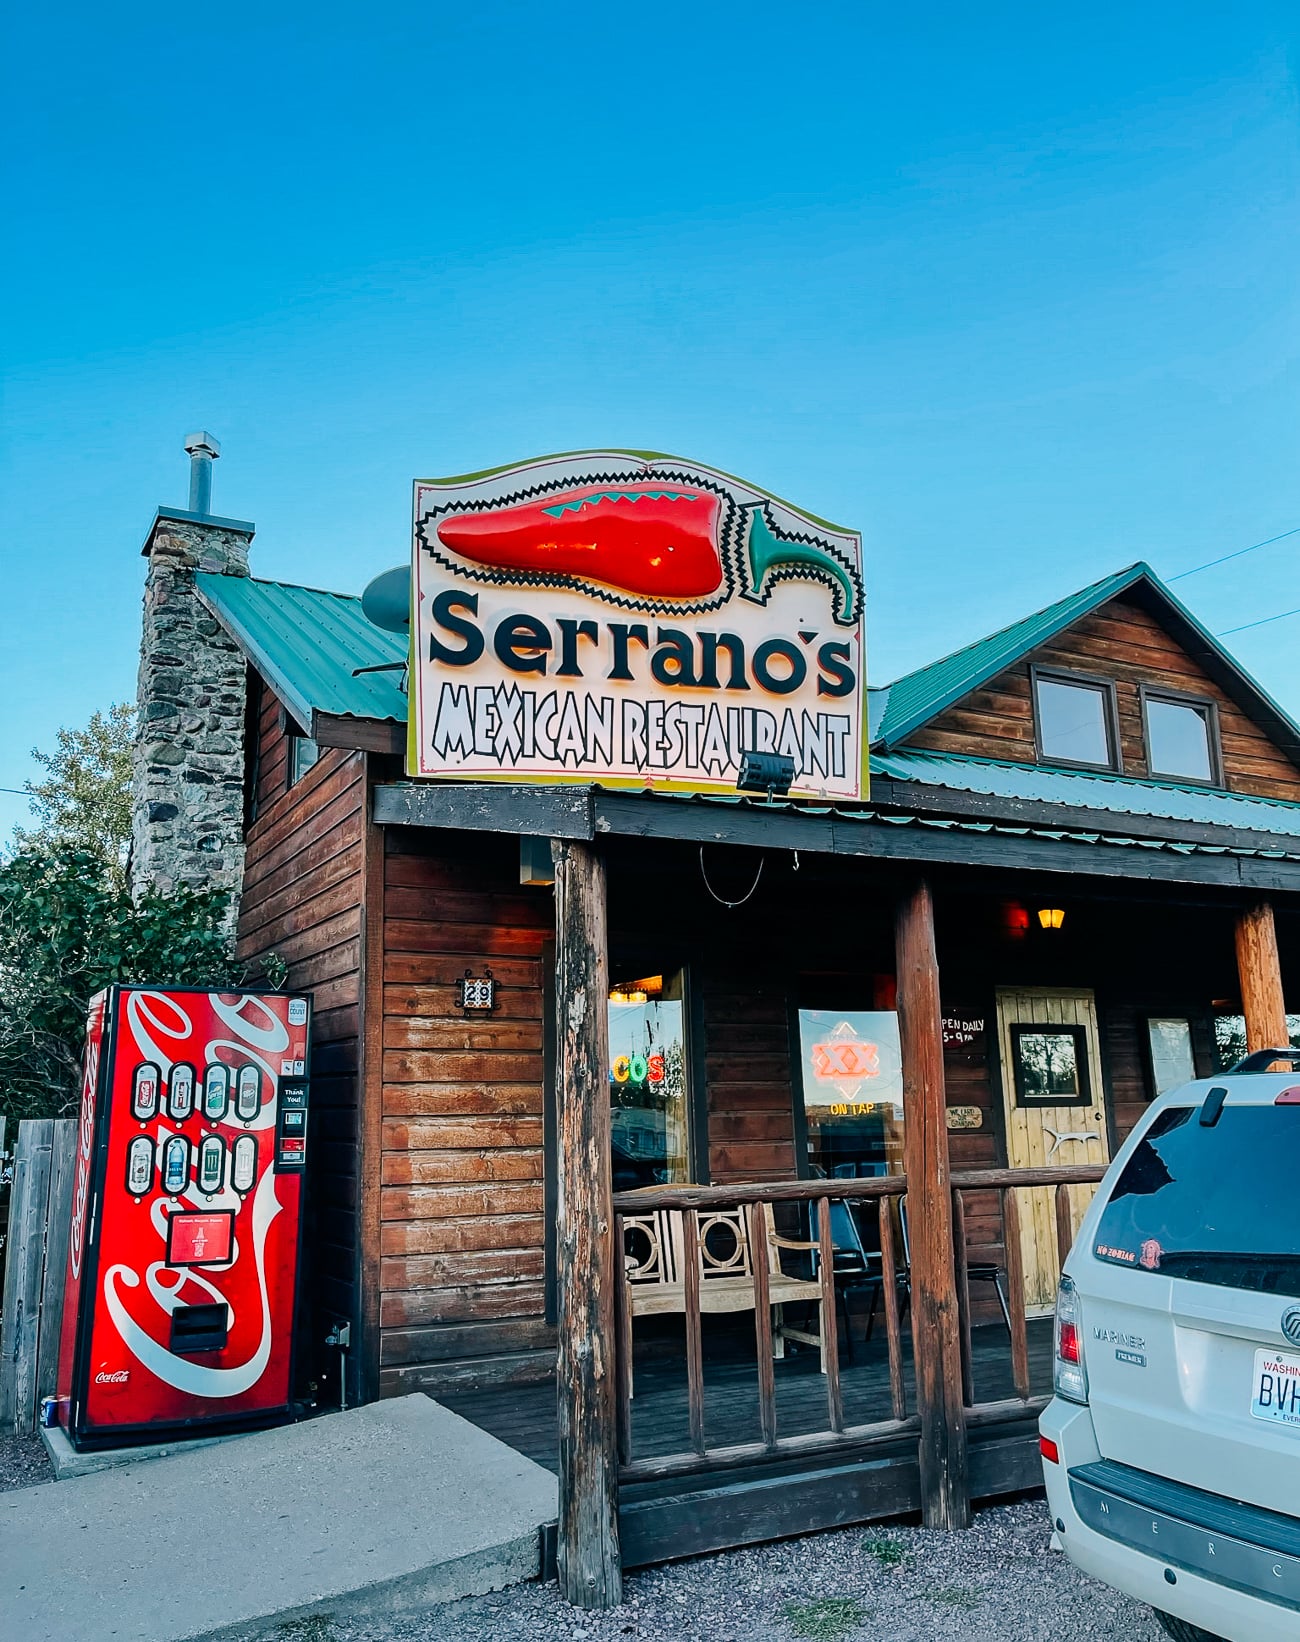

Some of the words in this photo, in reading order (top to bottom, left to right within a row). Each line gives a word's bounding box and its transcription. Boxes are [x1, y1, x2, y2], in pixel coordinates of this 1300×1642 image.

[429, 589, 856, 698] Serrano's
[432, 680, 614, 769] MEXICAN
[622, 698, 851, 780] RESTAURANT
[466, 985, 490, 1002] 29
[941, 1018, 961, 1030] PEN
[962, 1019, 984, 1031] DAILY
[943, 1031, 964, 1043] 5-9
[608, 1055, 665, 1083] COS
[830, 1103, 848, 1115] ON
[850, 1102, 874, 1115] TAP
[1093, 1326, 1145, 1350] MARINER
[95, 1370, 130, 1384] Coca-Cola
[1100, 1502, 1284, 1578] MERC
